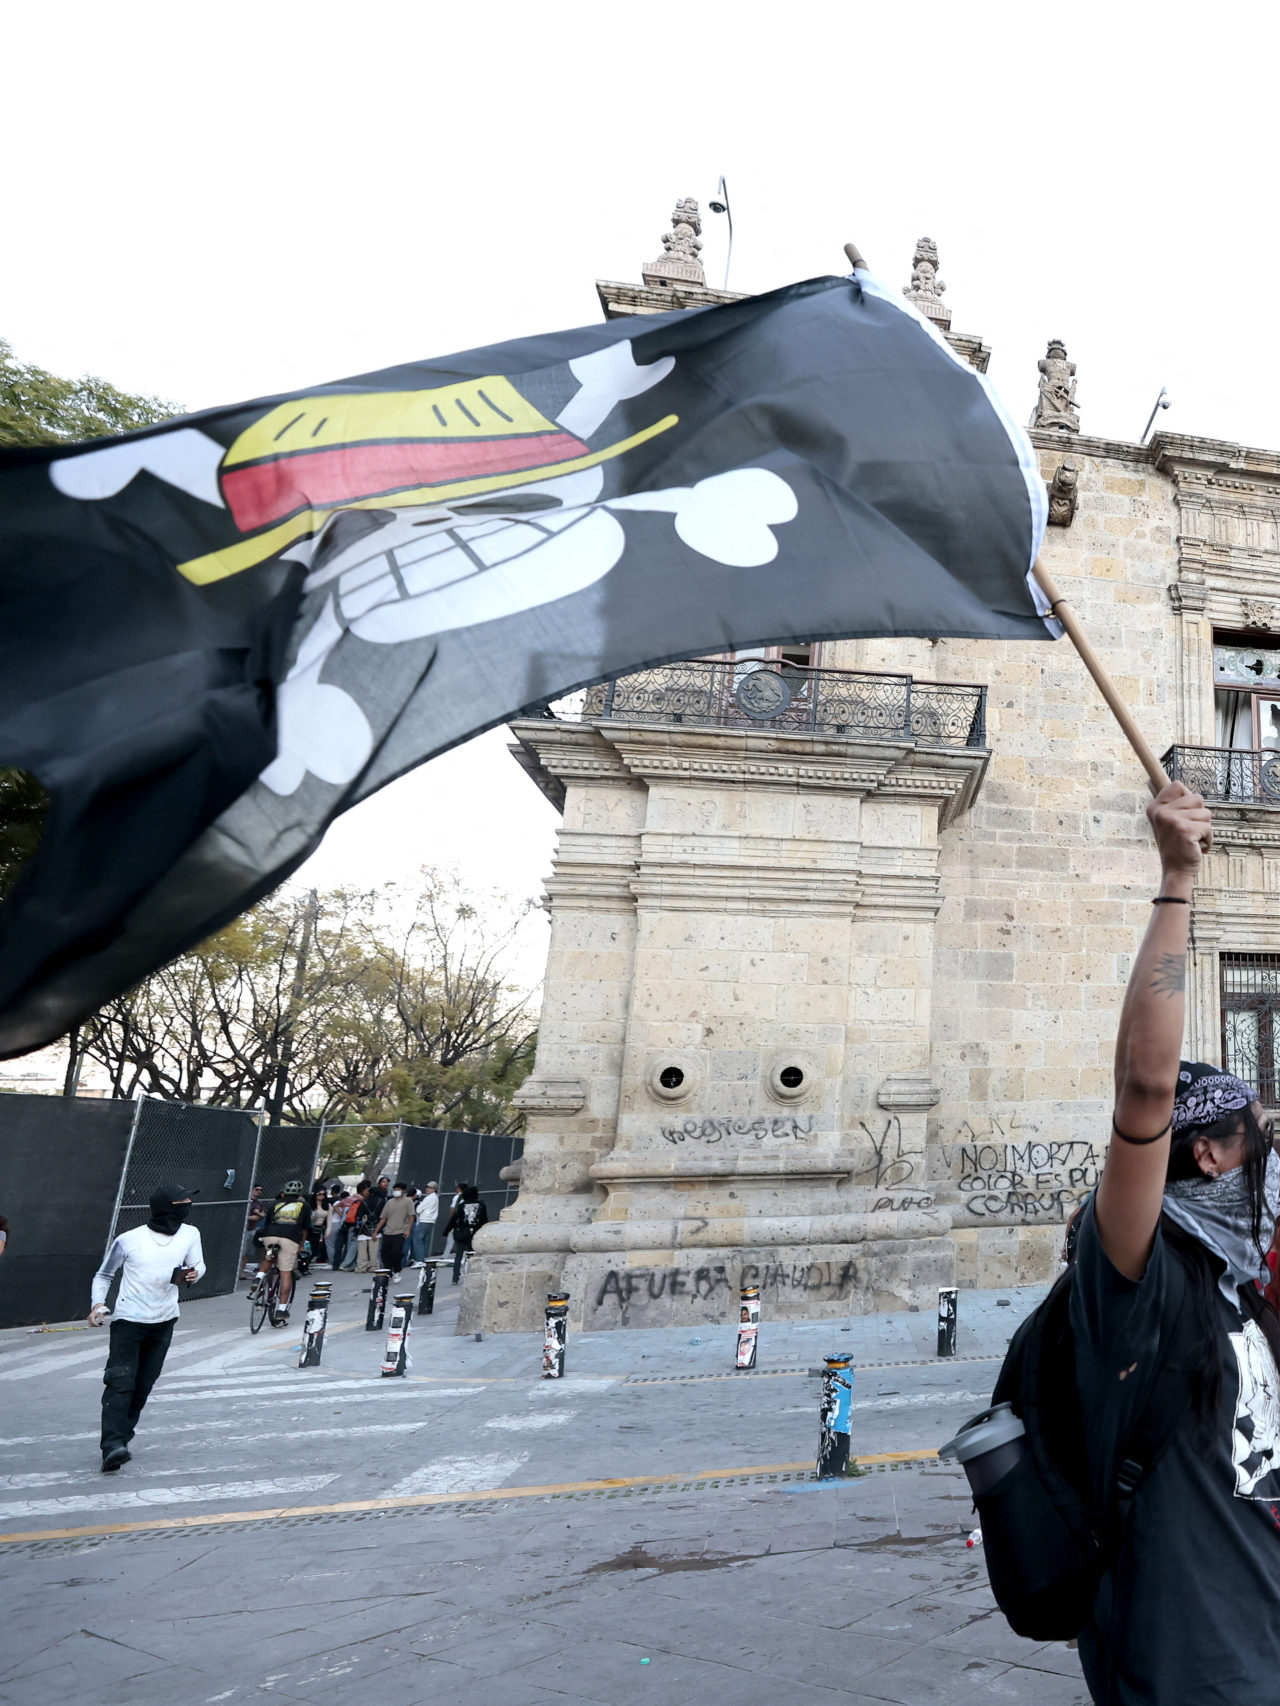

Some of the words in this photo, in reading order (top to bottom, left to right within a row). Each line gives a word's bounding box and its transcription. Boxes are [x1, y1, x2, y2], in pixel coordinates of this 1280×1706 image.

[960, 1145, 998, 1173] NO
[958, 1172, 1028, 1191] COLOR
[1036, 1172, 1063, 1189] ES
[1069, 1167, 1104, 1188] PU
[595, 1265, 732, 1306] AFUERA
